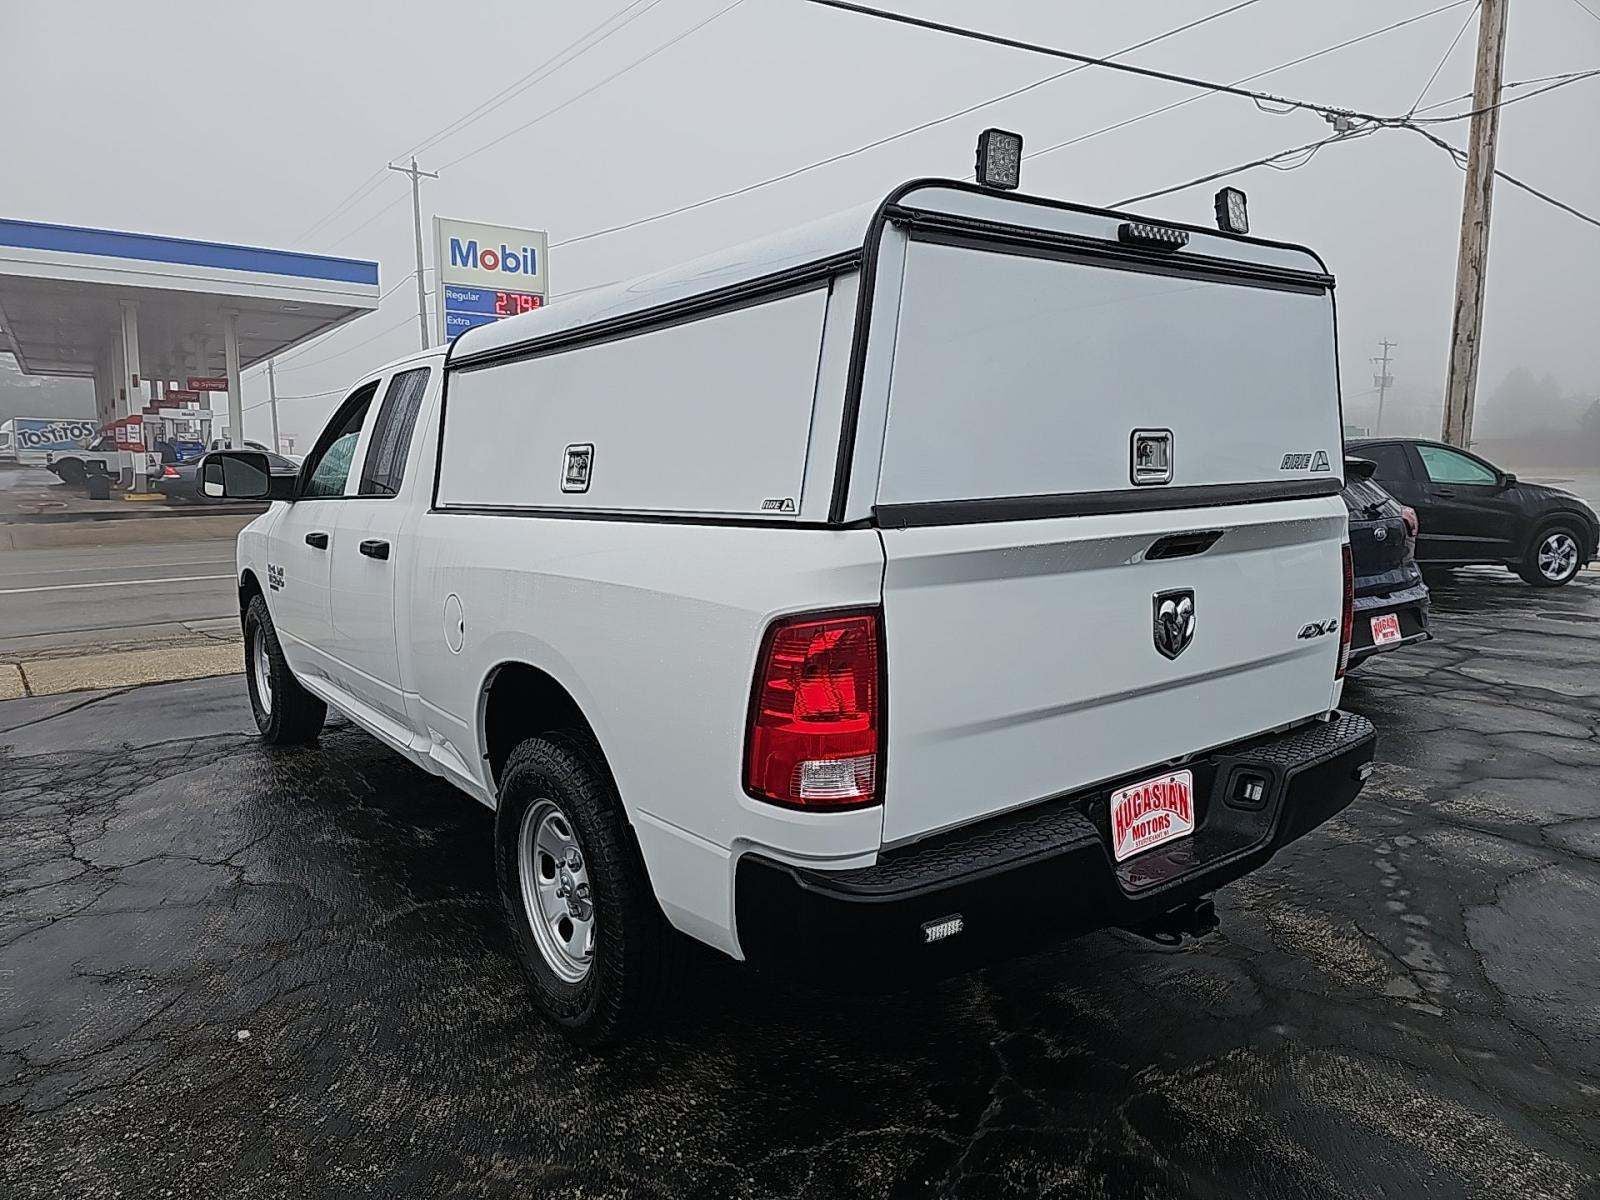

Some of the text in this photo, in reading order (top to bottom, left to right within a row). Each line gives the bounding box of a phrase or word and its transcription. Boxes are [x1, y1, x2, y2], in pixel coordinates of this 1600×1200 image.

[449, 237, 537, 276] Mobil
[446, 290, 480, 302] Regular
[447, 316, 470, 326] Extra
[1115, 781, 1190, 847] HUGASIAN
[1132, 813, 1171, 841] MOTORS
